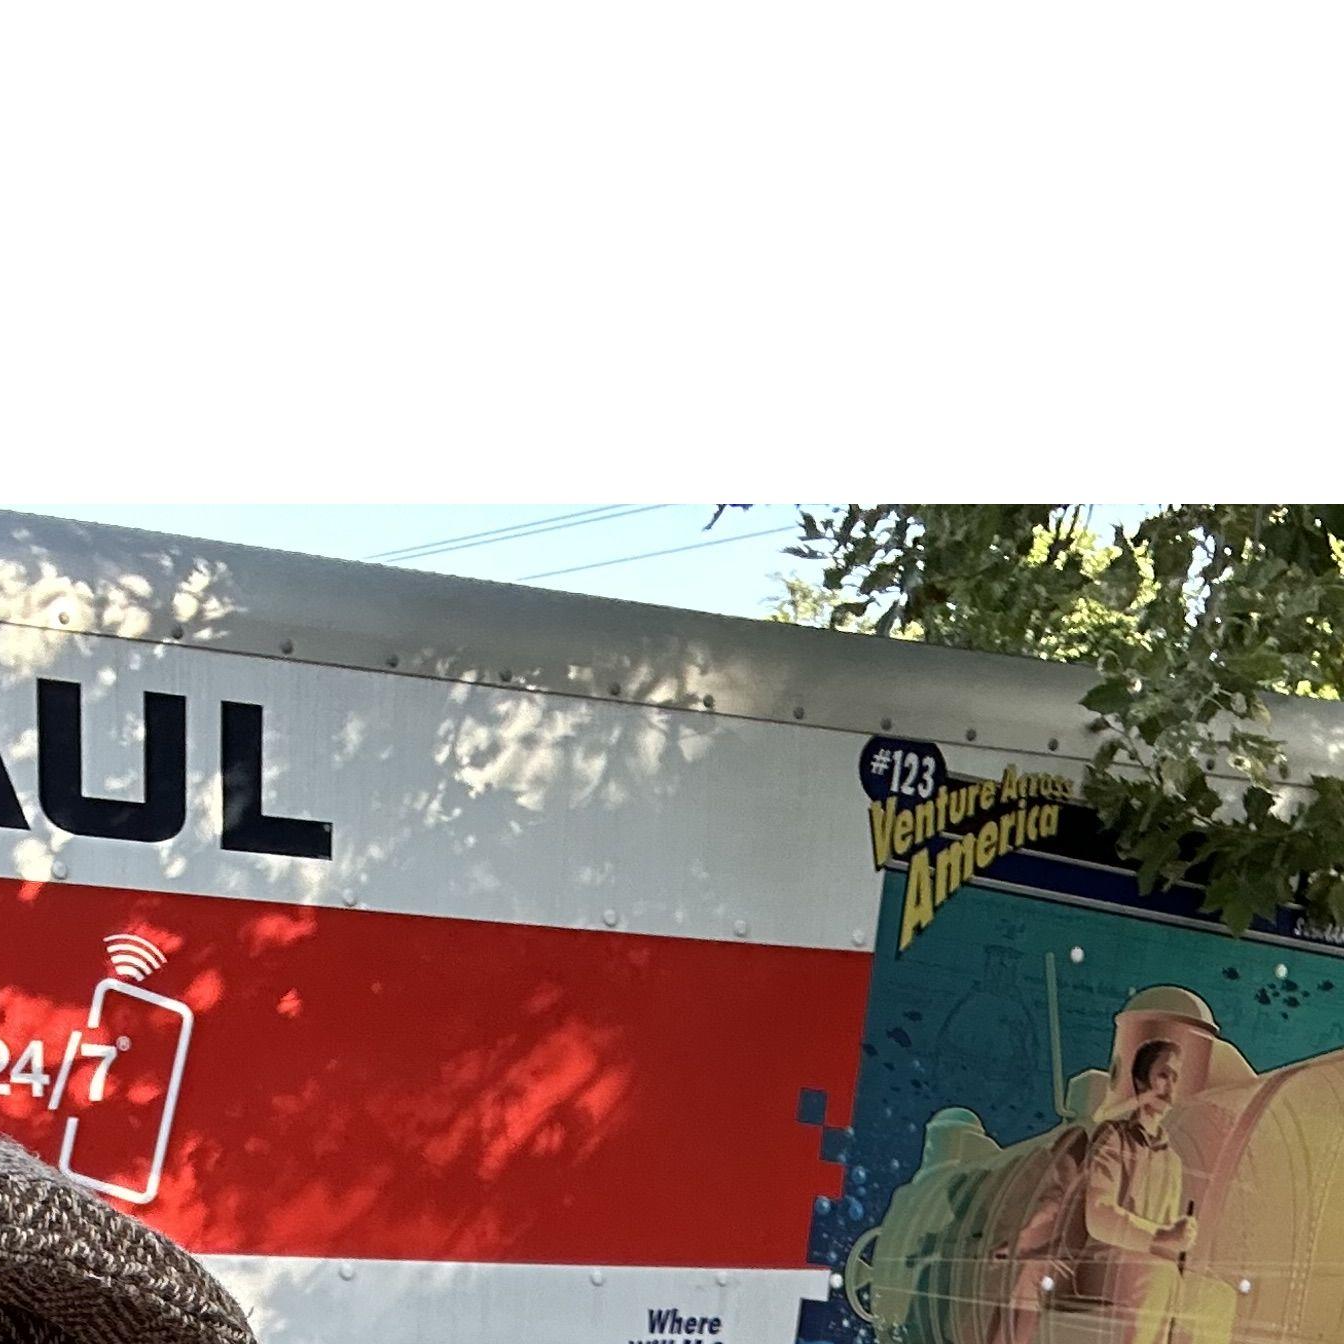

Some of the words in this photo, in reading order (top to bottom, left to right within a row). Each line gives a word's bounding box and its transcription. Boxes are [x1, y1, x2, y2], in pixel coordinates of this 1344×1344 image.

[870, 748, 935, 798] #123
[868, 777, 997, 871] Venture
[896, 799, 1060, 953] America
[648, 1308, 722, 1334] Where
